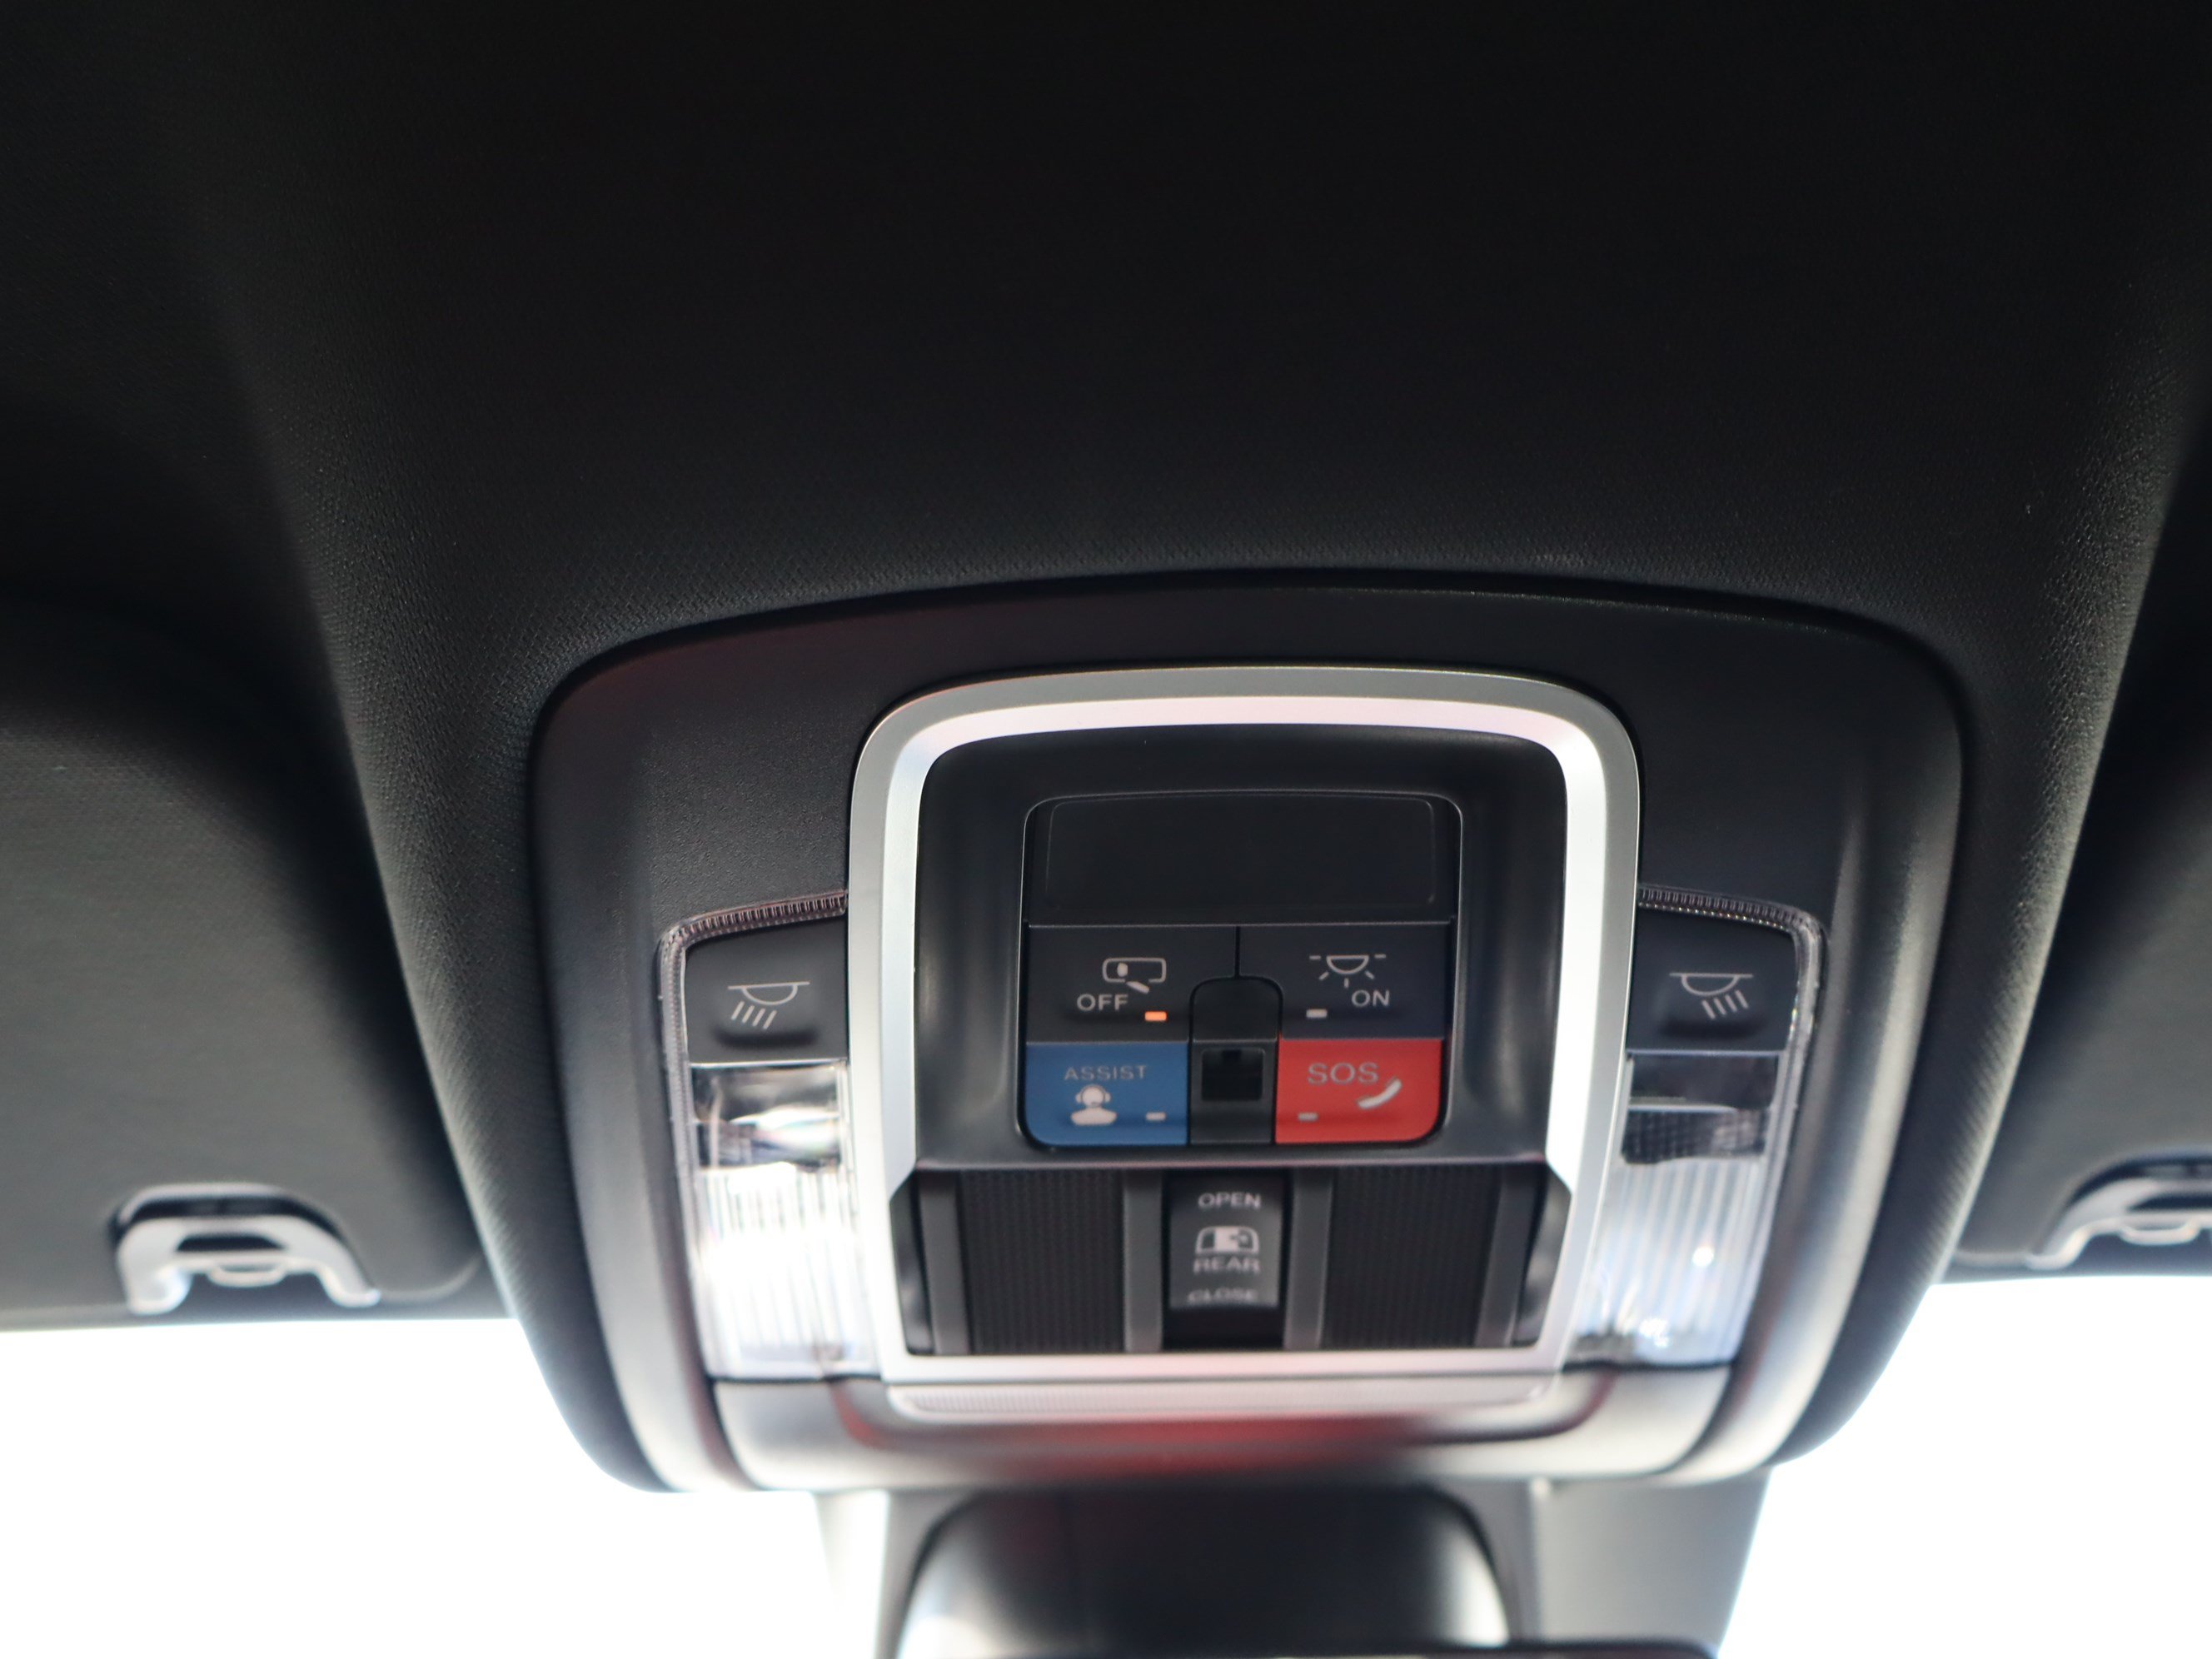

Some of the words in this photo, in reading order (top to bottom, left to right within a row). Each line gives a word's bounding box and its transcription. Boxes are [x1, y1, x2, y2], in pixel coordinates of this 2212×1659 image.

[1076, 993, 1128, 1012] OFF
[1351, 989, 1390, 1008] ON
[1064, 1065, 1148, 1080] ASSIST
[1307, 1062, 1379, 1085] SOS
[1198, 1193, 1262, 1210] OPEN
[1193, 1257, 1260, 1274] REAR
[1187, 1288, 1259, 1303] CLOSE
